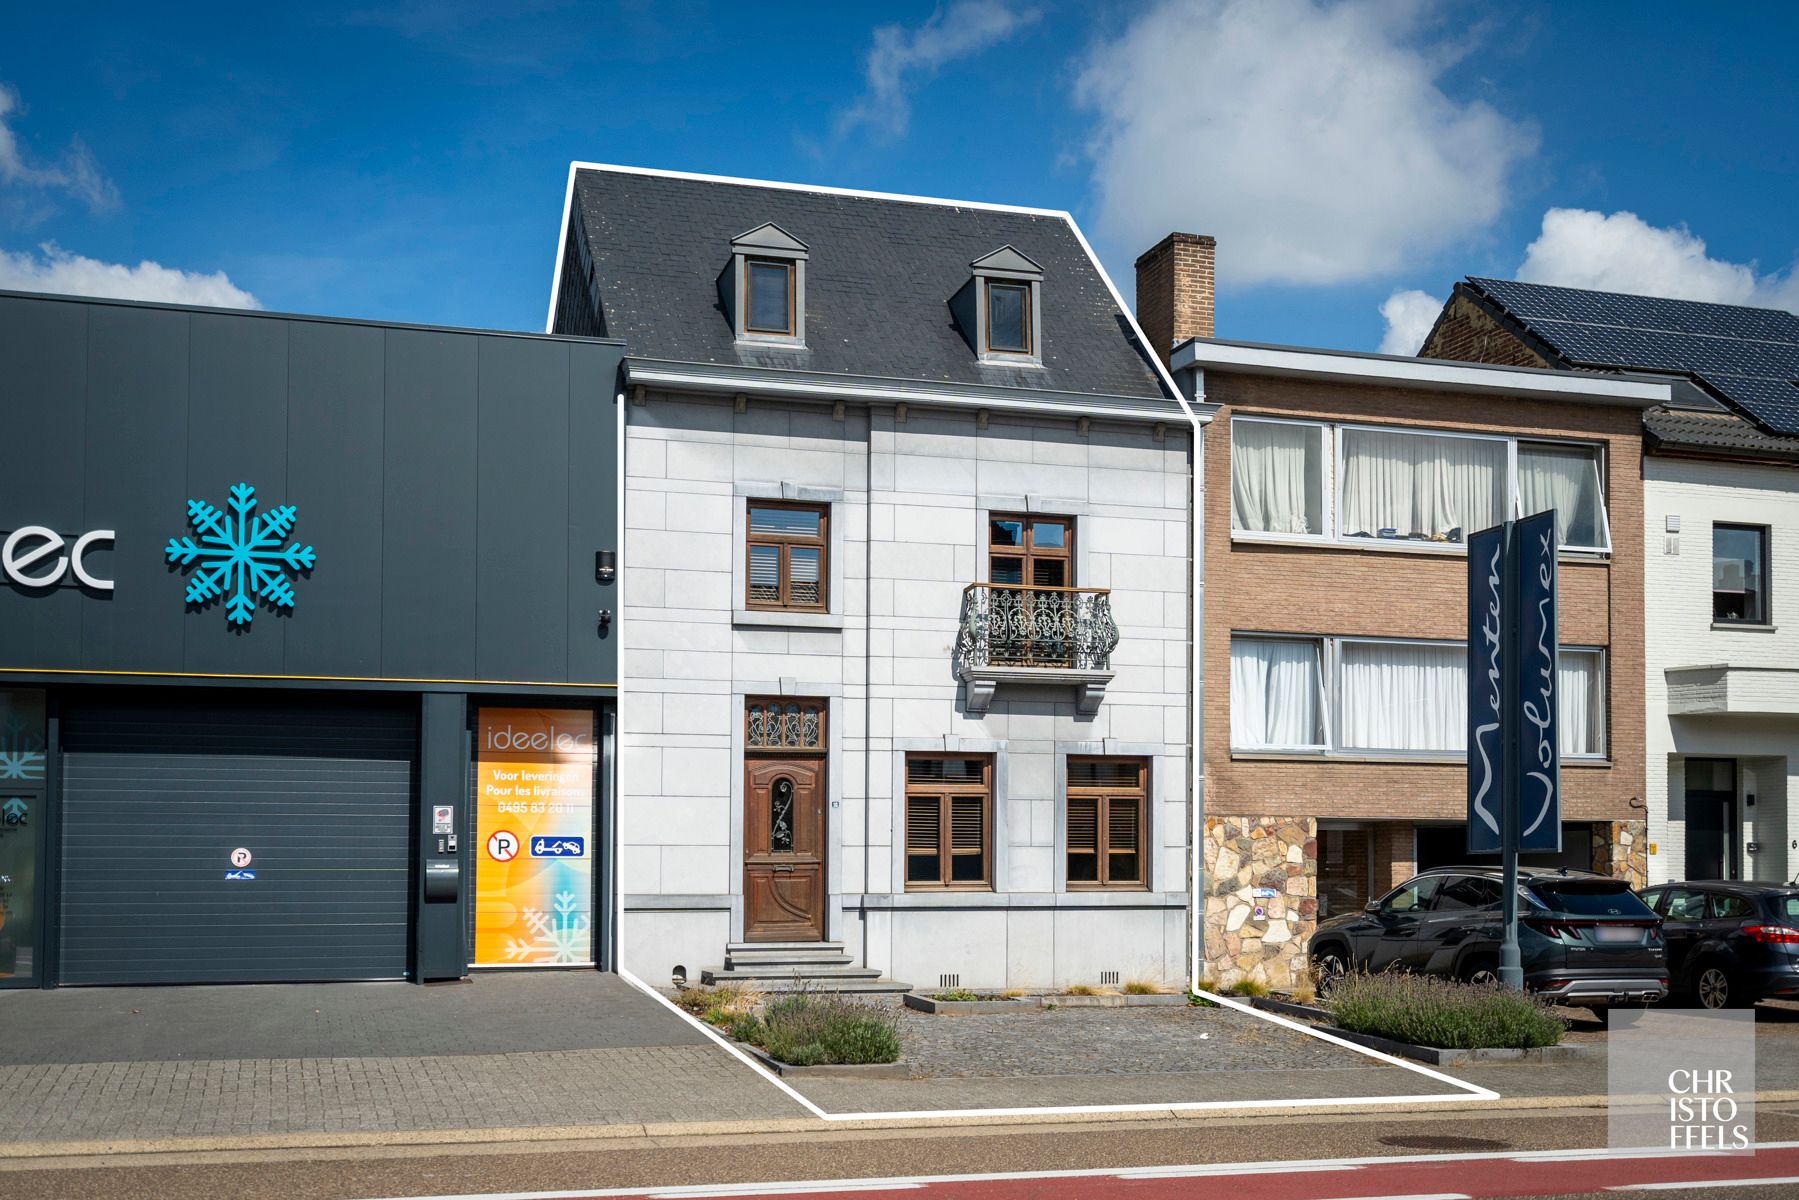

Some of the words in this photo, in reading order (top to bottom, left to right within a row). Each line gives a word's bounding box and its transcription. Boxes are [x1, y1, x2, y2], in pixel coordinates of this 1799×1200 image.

[2, 525, 116, 590] ec
[487, 724, 587, 752] ideelec
[492, 769, 519, 781] Voor
[485, 784, 513, 796] Pour
[515, 784, 531, 796] les
[497, 801, 528, 814] 0495
[530, 801, 545, 814] 83
[497, 839, 511, 855] P
